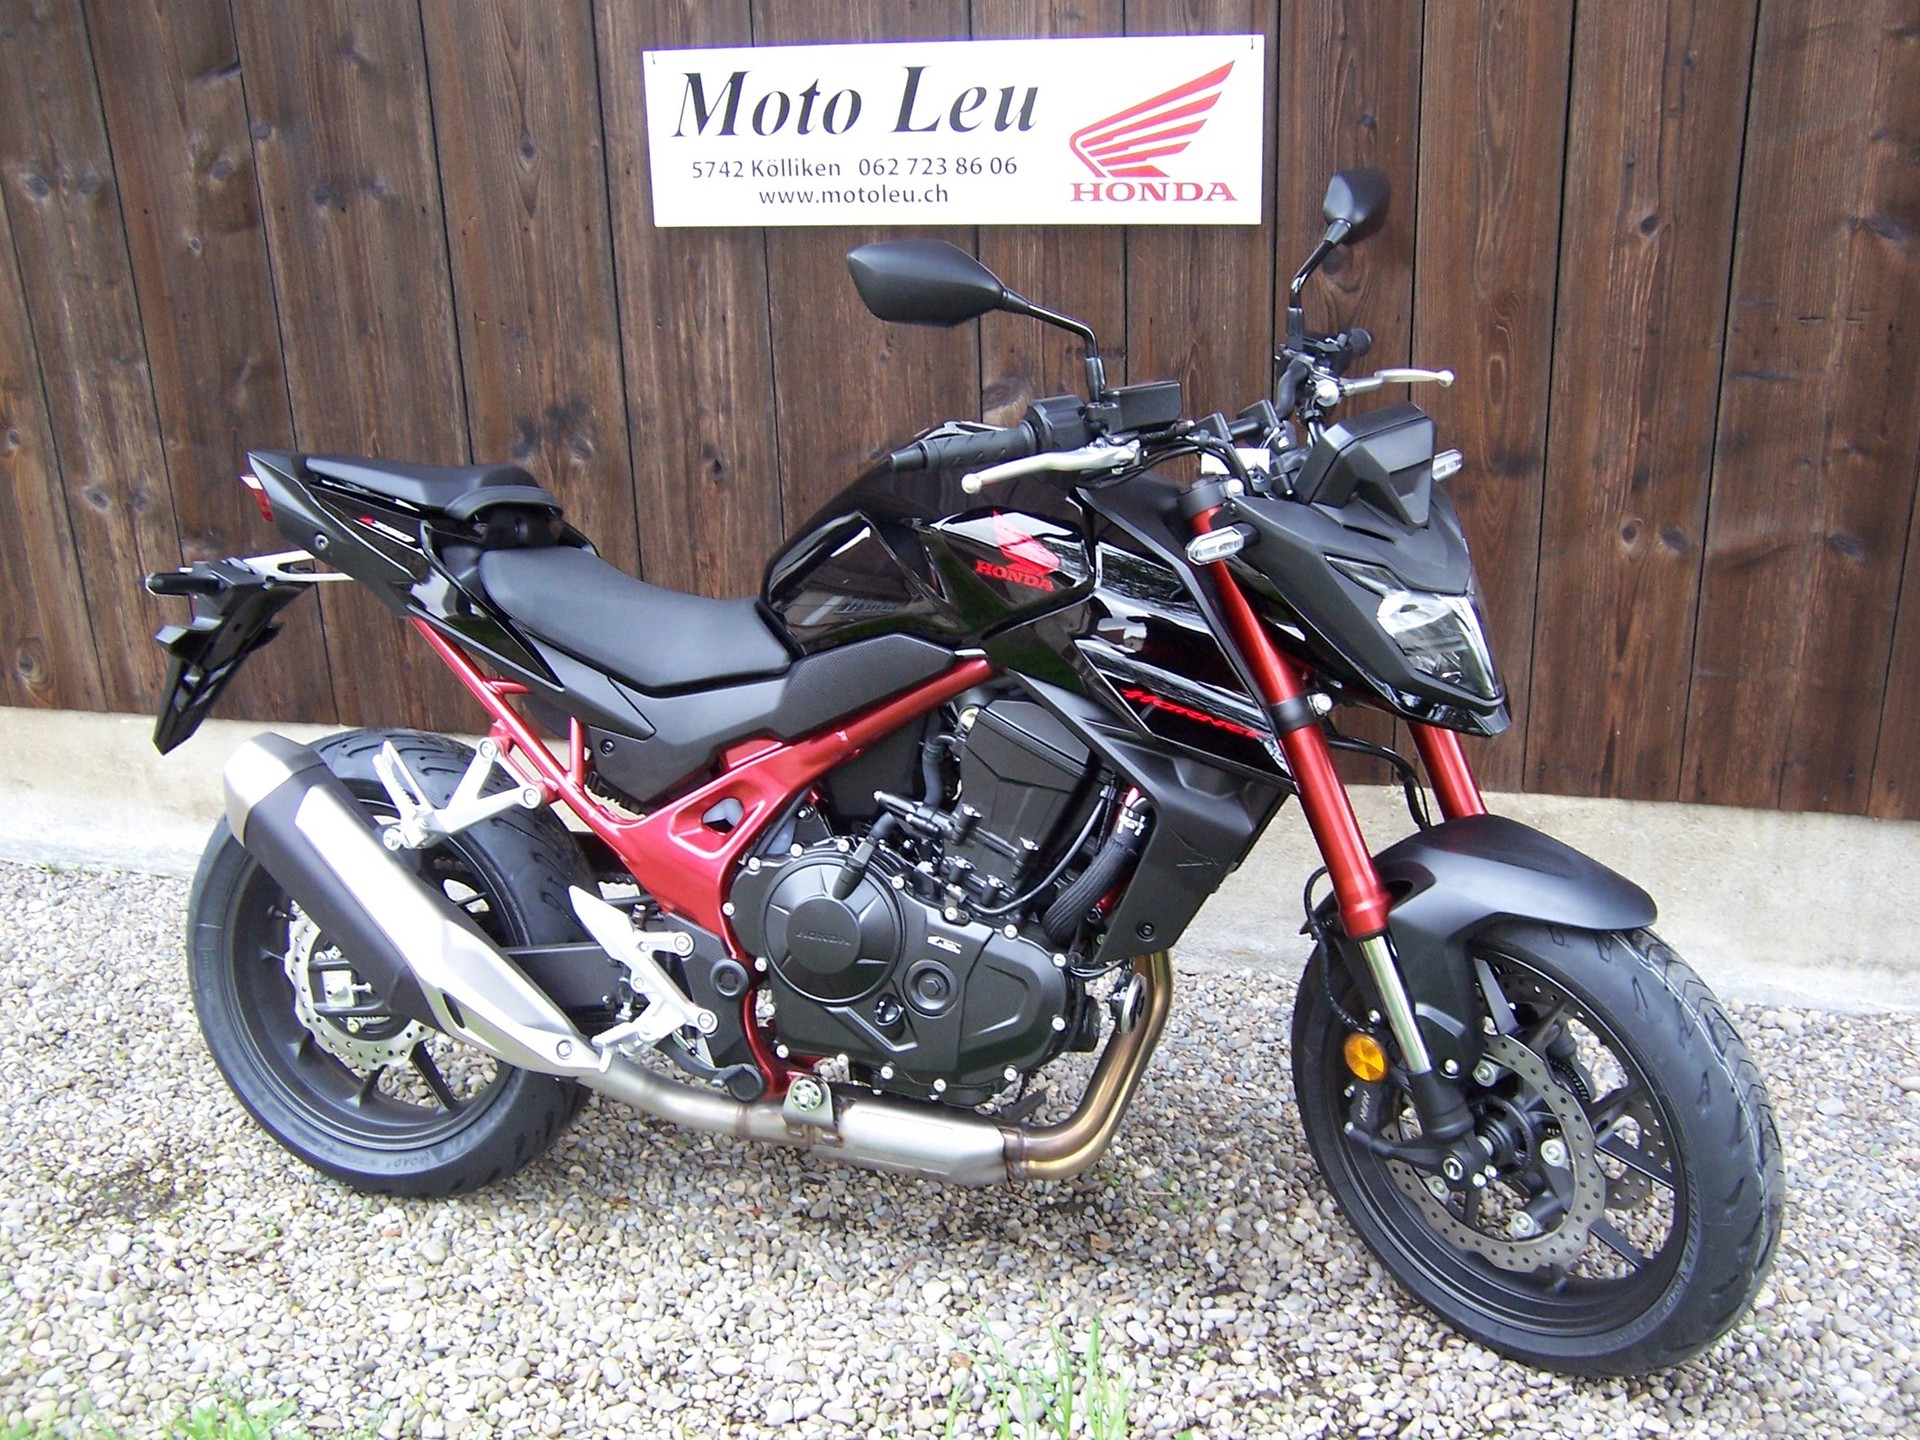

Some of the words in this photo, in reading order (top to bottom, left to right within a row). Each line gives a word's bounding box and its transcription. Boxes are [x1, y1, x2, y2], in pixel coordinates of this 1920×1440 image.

[671, 70, 862, 138] Moto
[890, 65, 1039, 133] Leu
[692, 160, 744, 179] 5742
[751, 158, 841, 178] Kölliken
[858, 158, 899, 176] 062
[907, 157, 947, 175] 723
[955, 156, 983, 175] 86
[990, 156, 1017, 175] 06
[759, 183, 948, 205] www.motoleu.ch
[1071, 182, 1238, 202] HONDA
[975, 559, 1056, 593] HONDA
